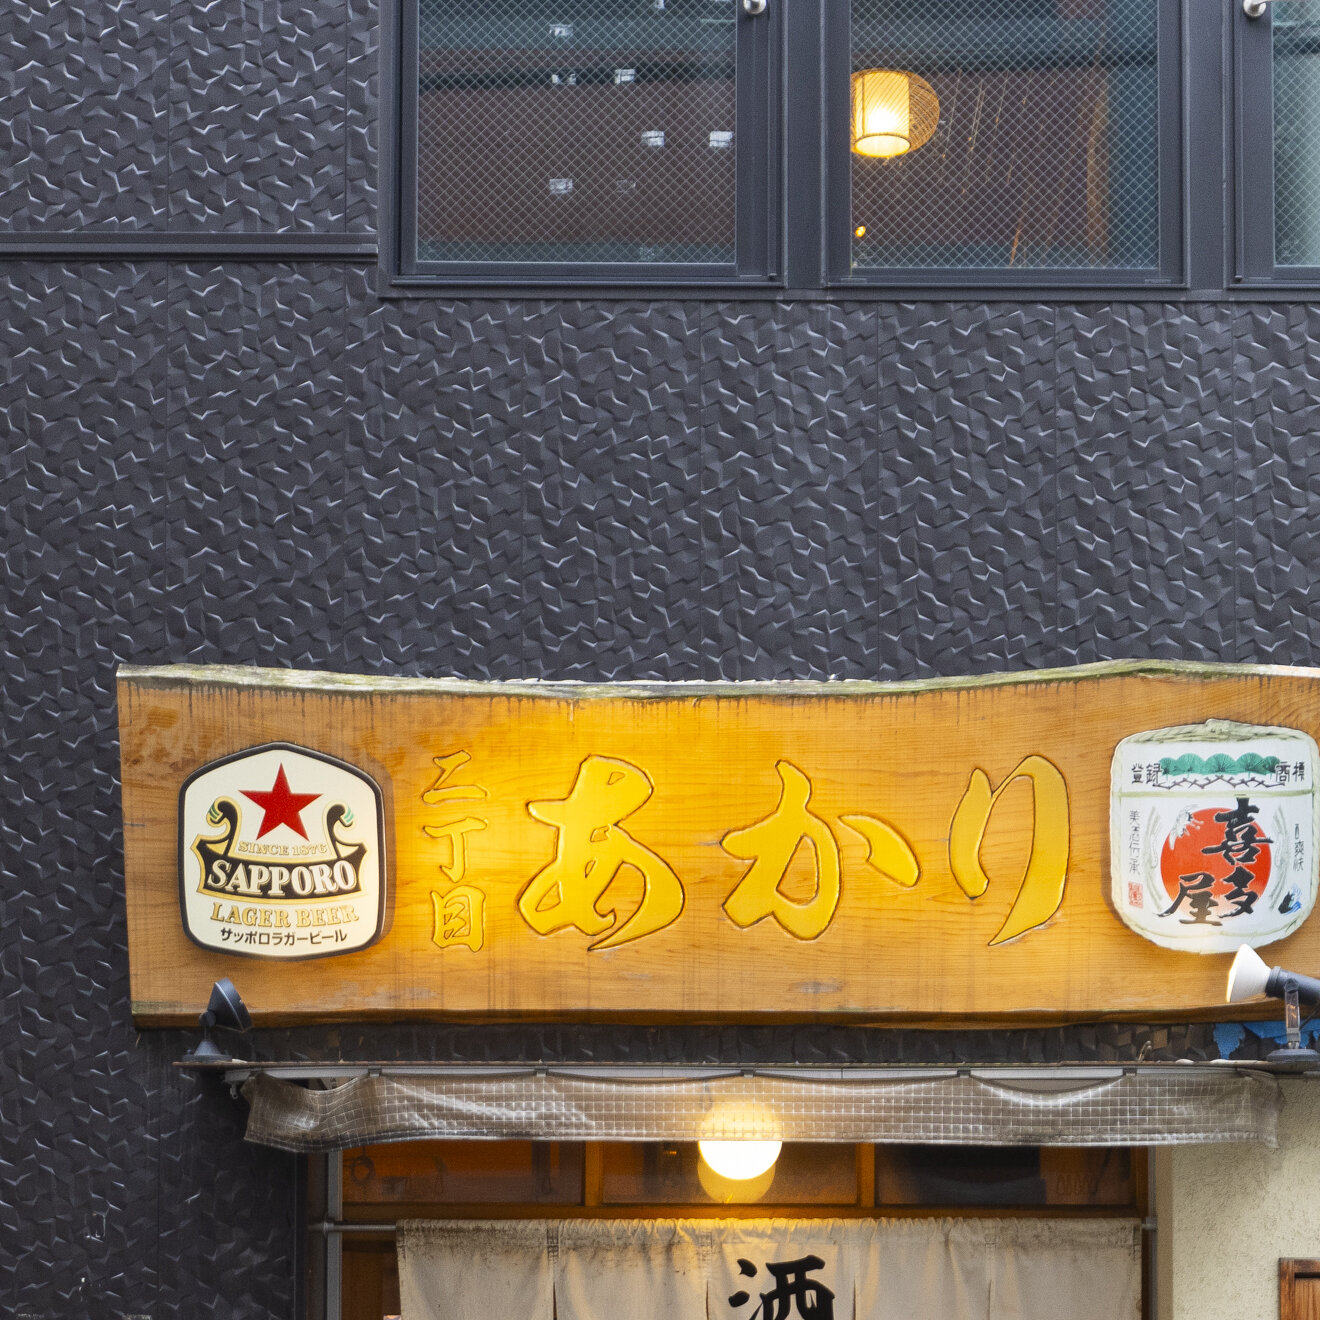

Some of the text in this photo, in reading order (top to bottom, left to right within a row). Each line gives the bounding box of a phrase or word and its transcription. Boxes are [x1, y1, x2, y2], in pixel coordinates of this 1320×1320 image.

[237, 840, 328, 856] SINCE 1876
[421, 749, 488, 953] 二丁目
[518, 753, 1071, 952] あかり
[1152, 797, 1275, 926] 喜多屋
[206, 859, 357, 896] SAPPORO
[210, 902, 359, 928] LAGER BEER
[220, 926, 348, 946] サッポロラガービール
